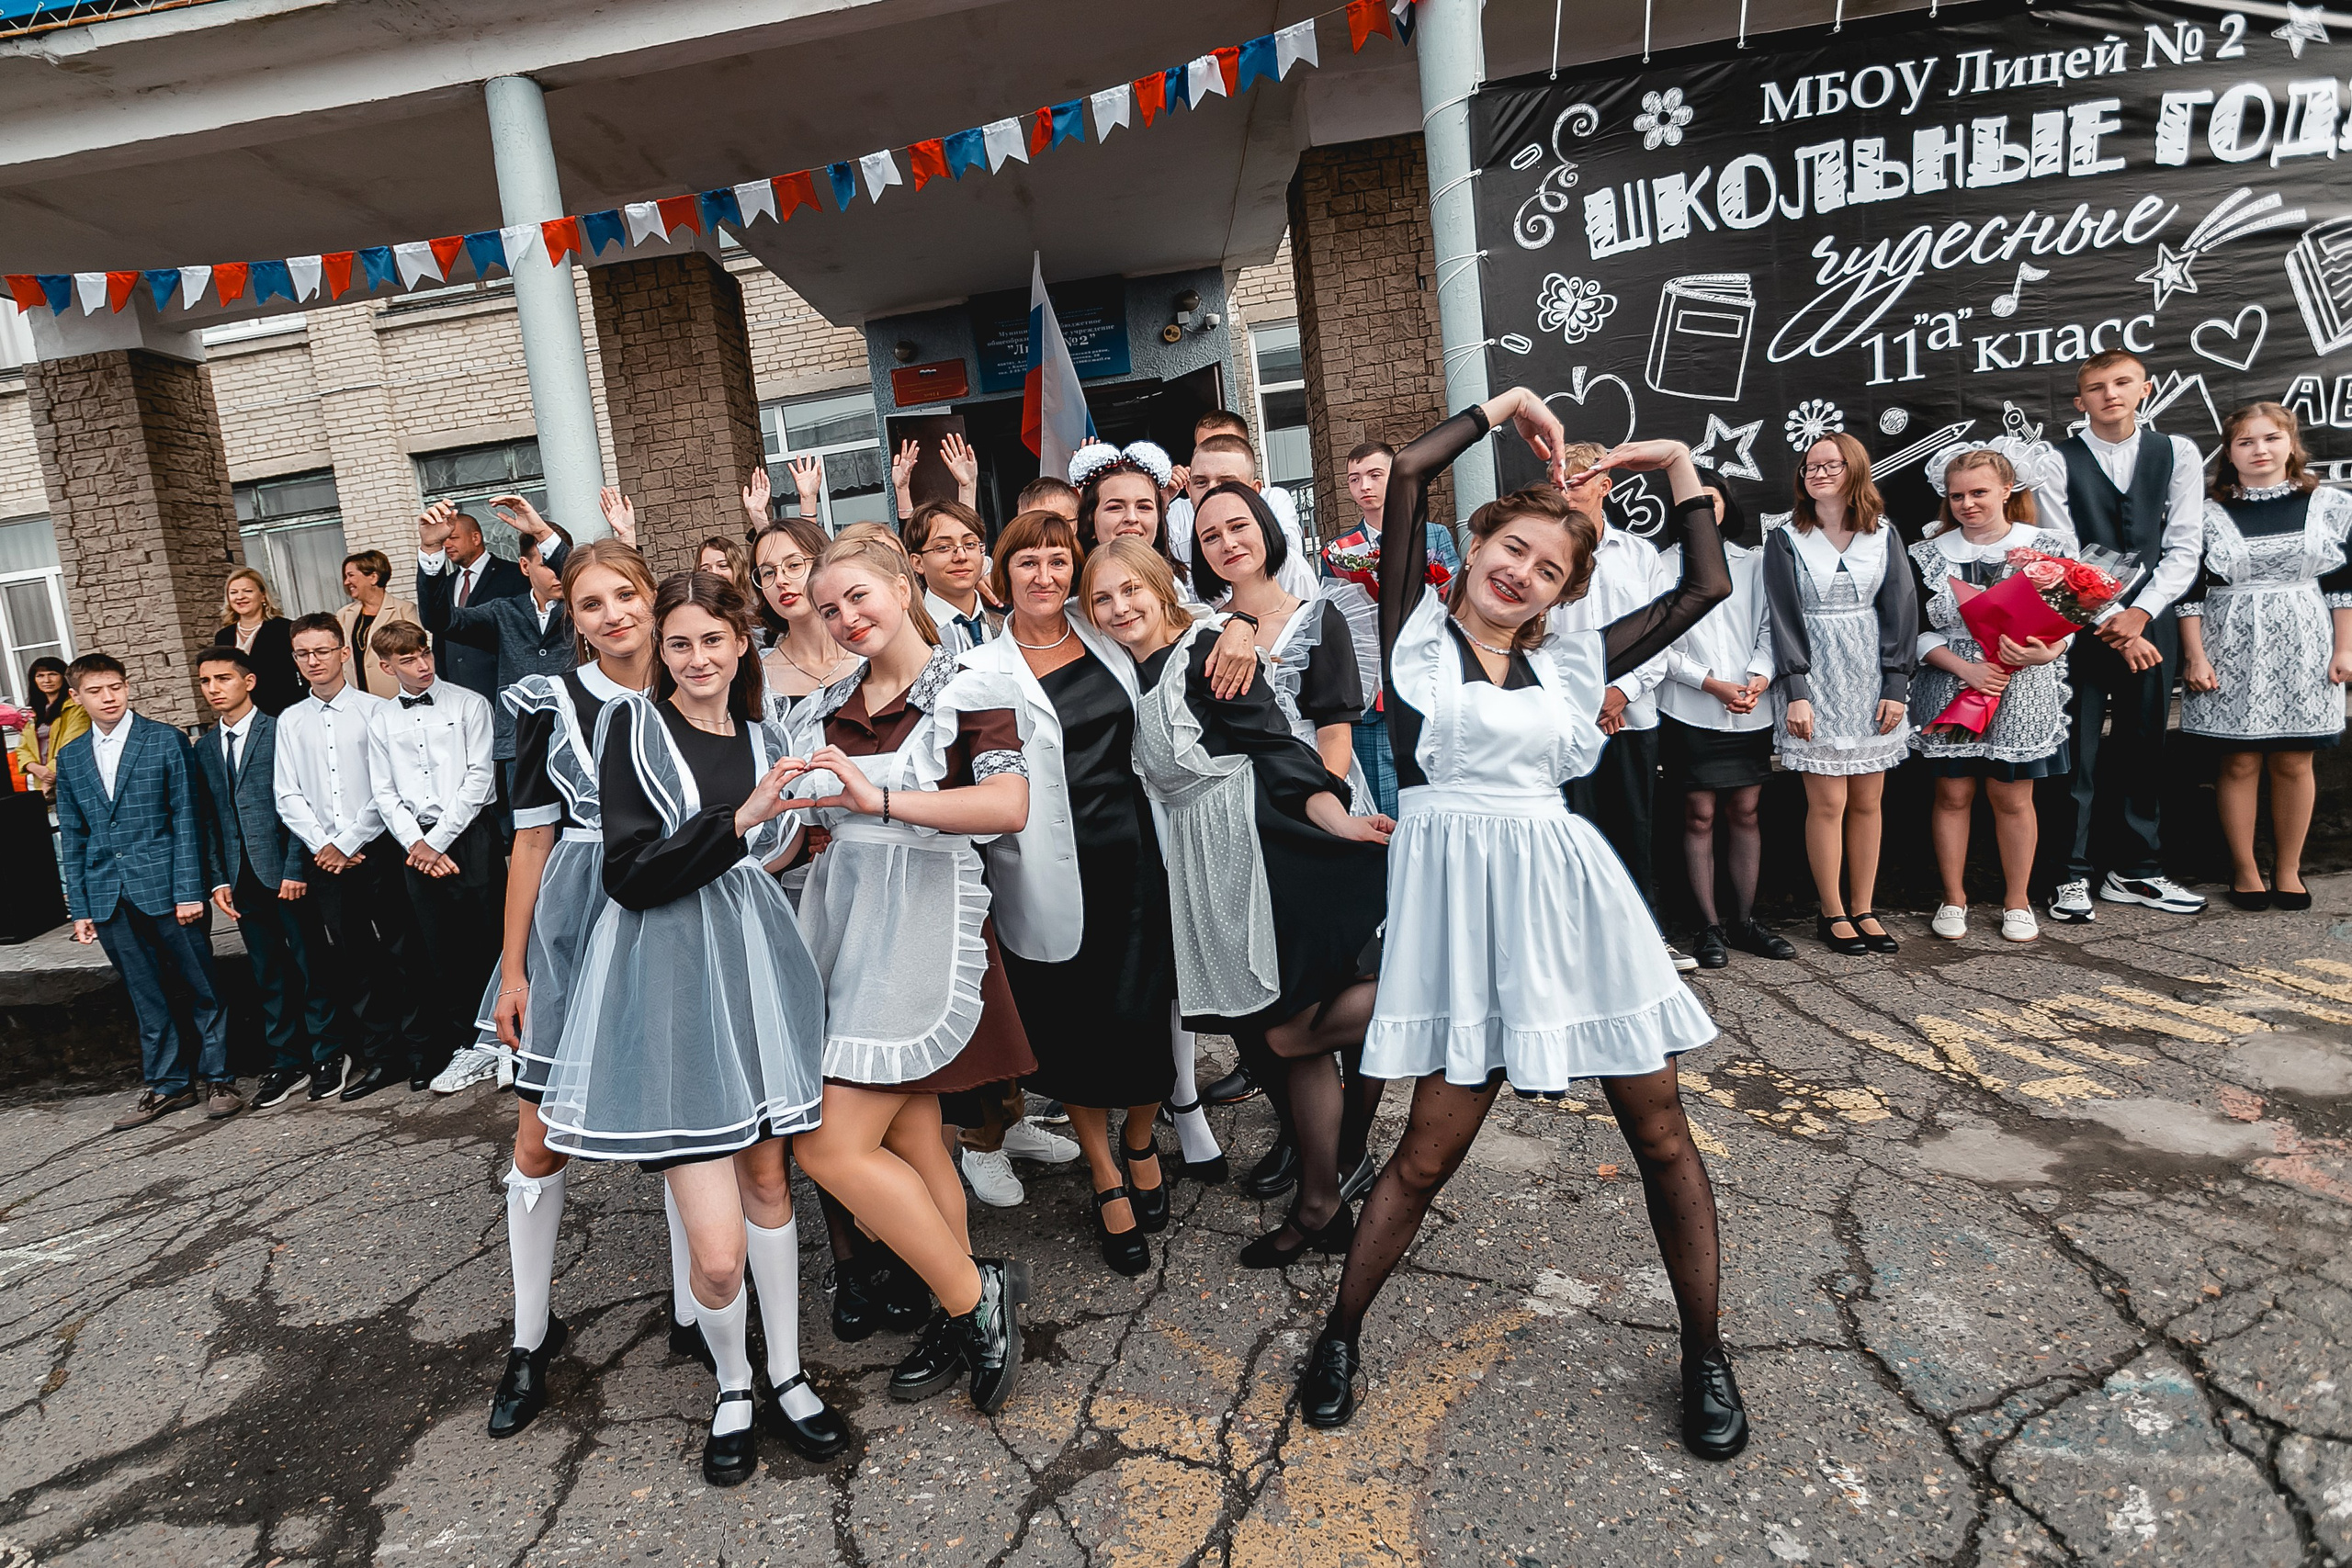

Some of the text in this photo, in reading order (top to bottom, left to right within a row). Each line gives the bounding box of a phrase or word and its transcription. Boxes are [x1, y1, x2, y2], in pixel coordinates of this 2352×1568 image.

[1759, 13, 2247, 125] МБОУ Лицей № 2
[1584, 77, 2352, 260] ШКОЛЬНЫЕ ГОД
[1767, 195, 2179, 362] чудесные
[1973, 313, 2155, 373] класс
[1608, 473, 1666, 538] 3
